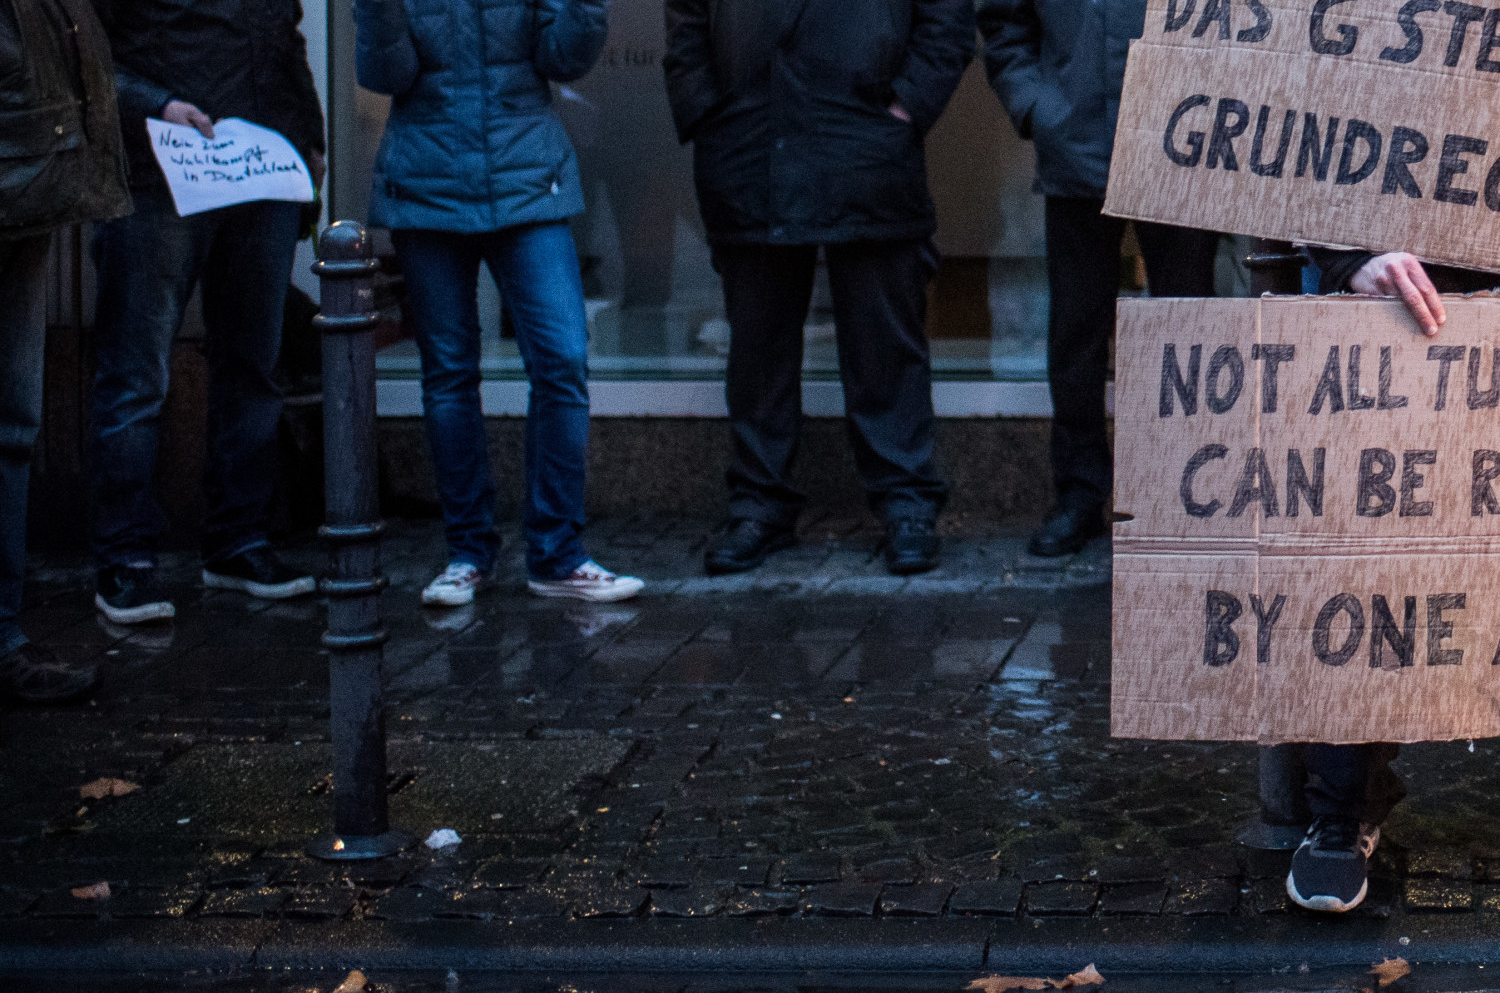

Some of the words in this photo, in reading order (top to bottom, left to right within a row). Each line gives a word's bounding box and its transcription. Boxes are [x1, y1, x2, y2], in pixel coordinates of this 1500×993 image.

[160, 129, 193, 148] Nein
[170, 145, 268, 166] Wahlkampf
[204, 160, 302, 183] Deutschland
[1158, 343, 1295, 417] NOT
[1307, 345, 1408, 415] ALL
[1180, 443, 1326, 518] CAN
[1356, 447, 1437, 518] BE
[1203, 589, 1287, 667] BY
[1312, 592, 1466, 669] ONE
